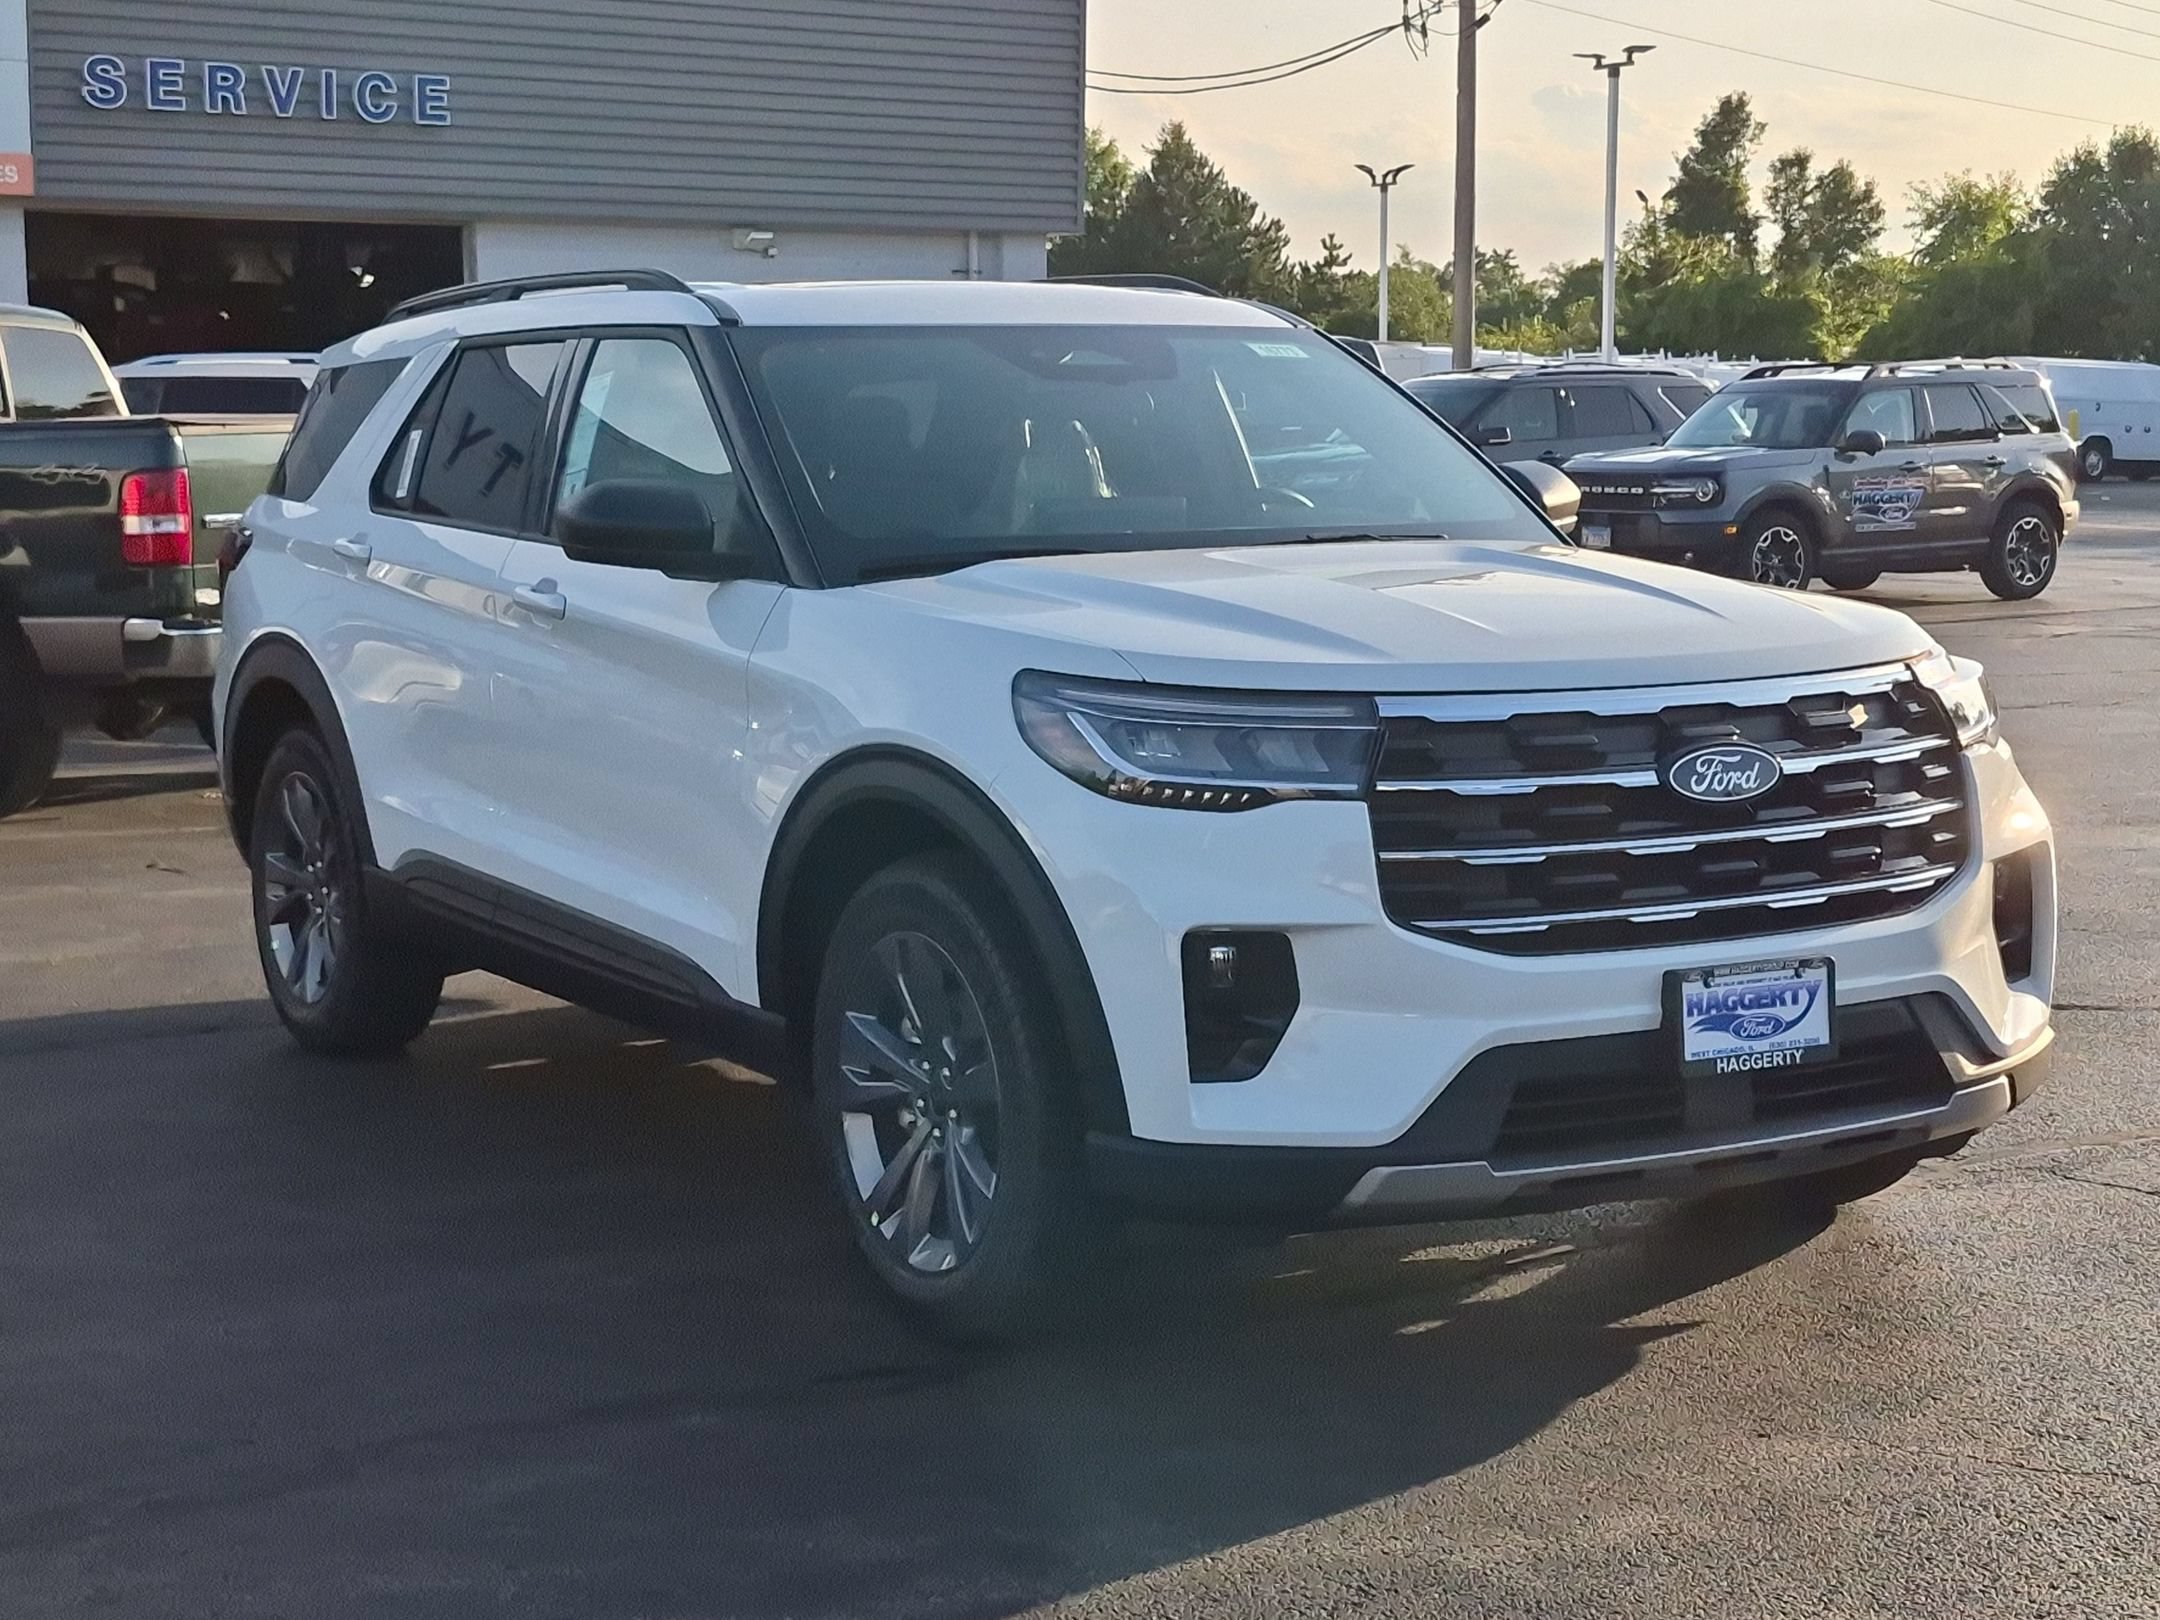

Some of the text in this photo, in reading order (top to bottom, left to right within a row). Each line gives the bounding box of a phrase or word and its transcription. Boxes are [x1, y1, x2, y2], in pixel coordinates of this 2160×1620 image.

[82, 55, 451, 126] SERVICE
[1580, 485, 1644, 495] RONCO
[1690, 754, 1761, 793] Ford
[1686, 980, 1822, 1017] HAGGERTY
[1740, 1018, 1774, 1037] Ford
[1716, 1050, 1803, 1073] HAGGERTY
